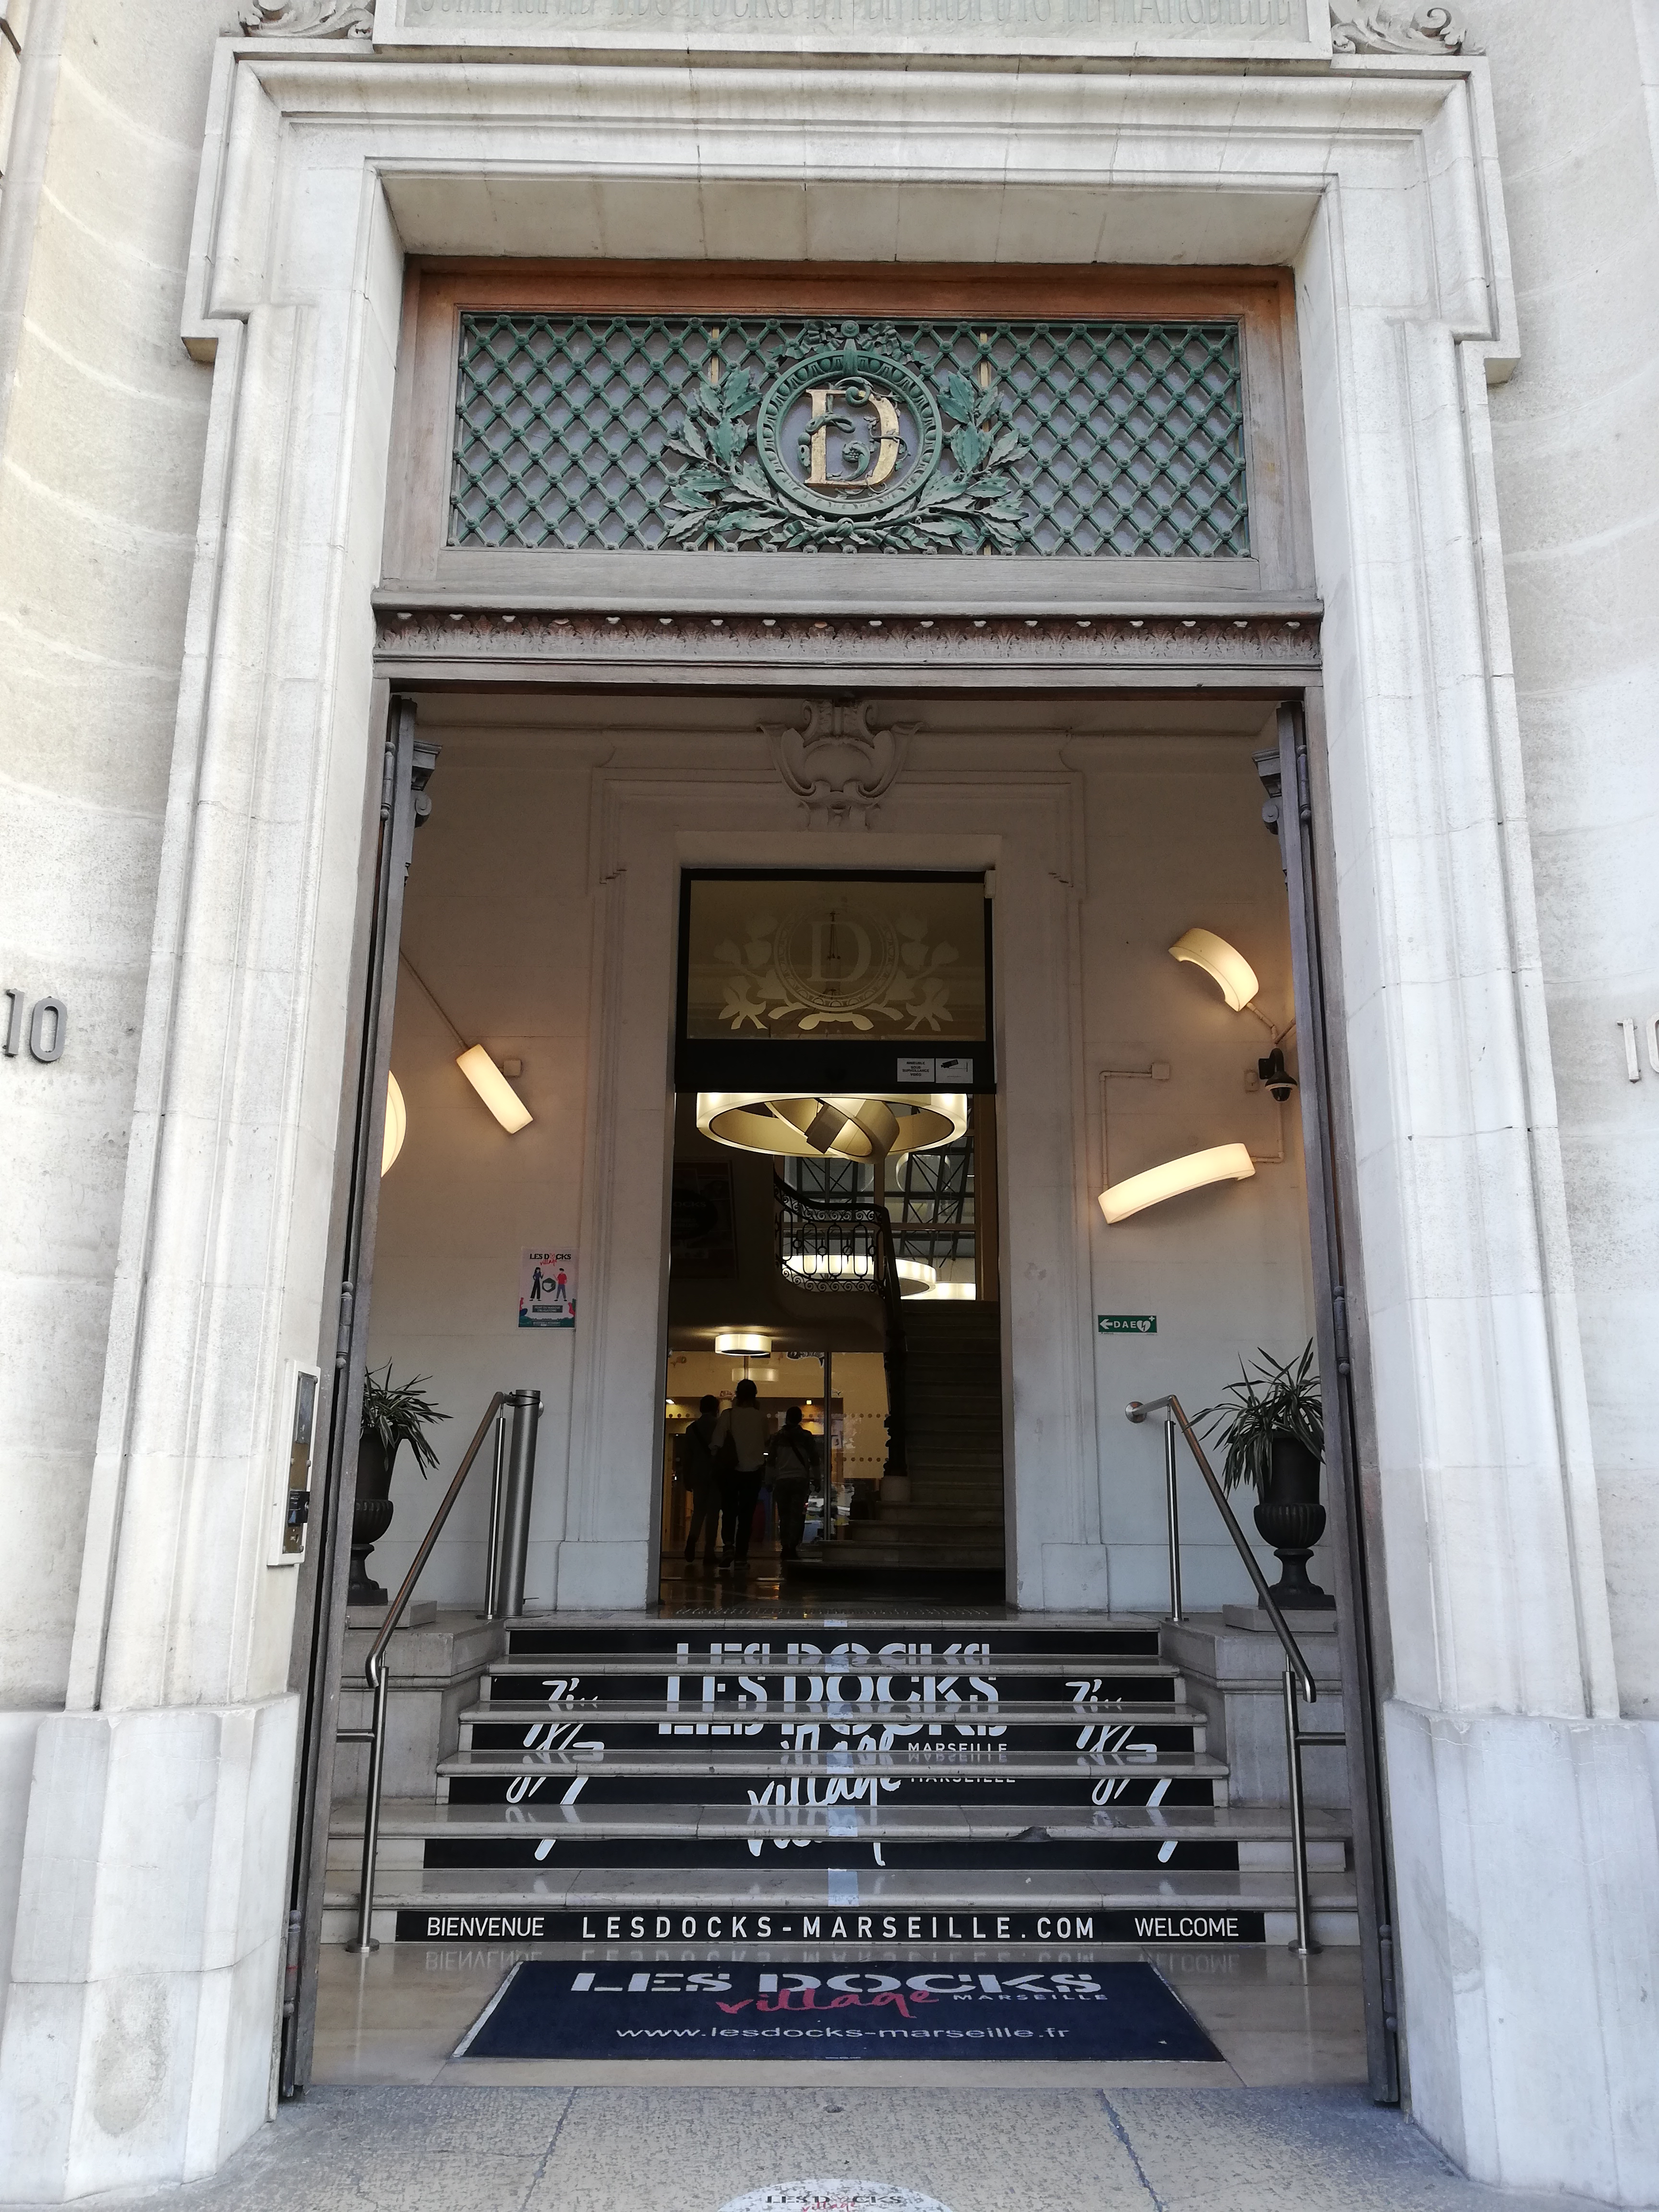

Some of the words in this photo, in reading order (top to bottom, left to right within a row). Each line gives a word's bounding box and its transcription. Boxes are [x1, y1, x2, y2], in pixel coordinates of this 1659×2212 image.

[4, 987, 68, 1063] 10
[427, 1917, 545, 1937] BIENVENUE
[582, 1916, 1094, 1938] LESDOCKS-MARSEILLE.COM
[1134, 1917, 1239, 1937] WELCOME
[571, 1972, 733, 1992] LES
[758, 1973, 1102, 1993] DOCKS
[715, 1987, 939, 2018] village
[616, 2027, 1070, 2038] www.lesdocks-marseille.fr
[766, 2195, 808, 2203] LES
